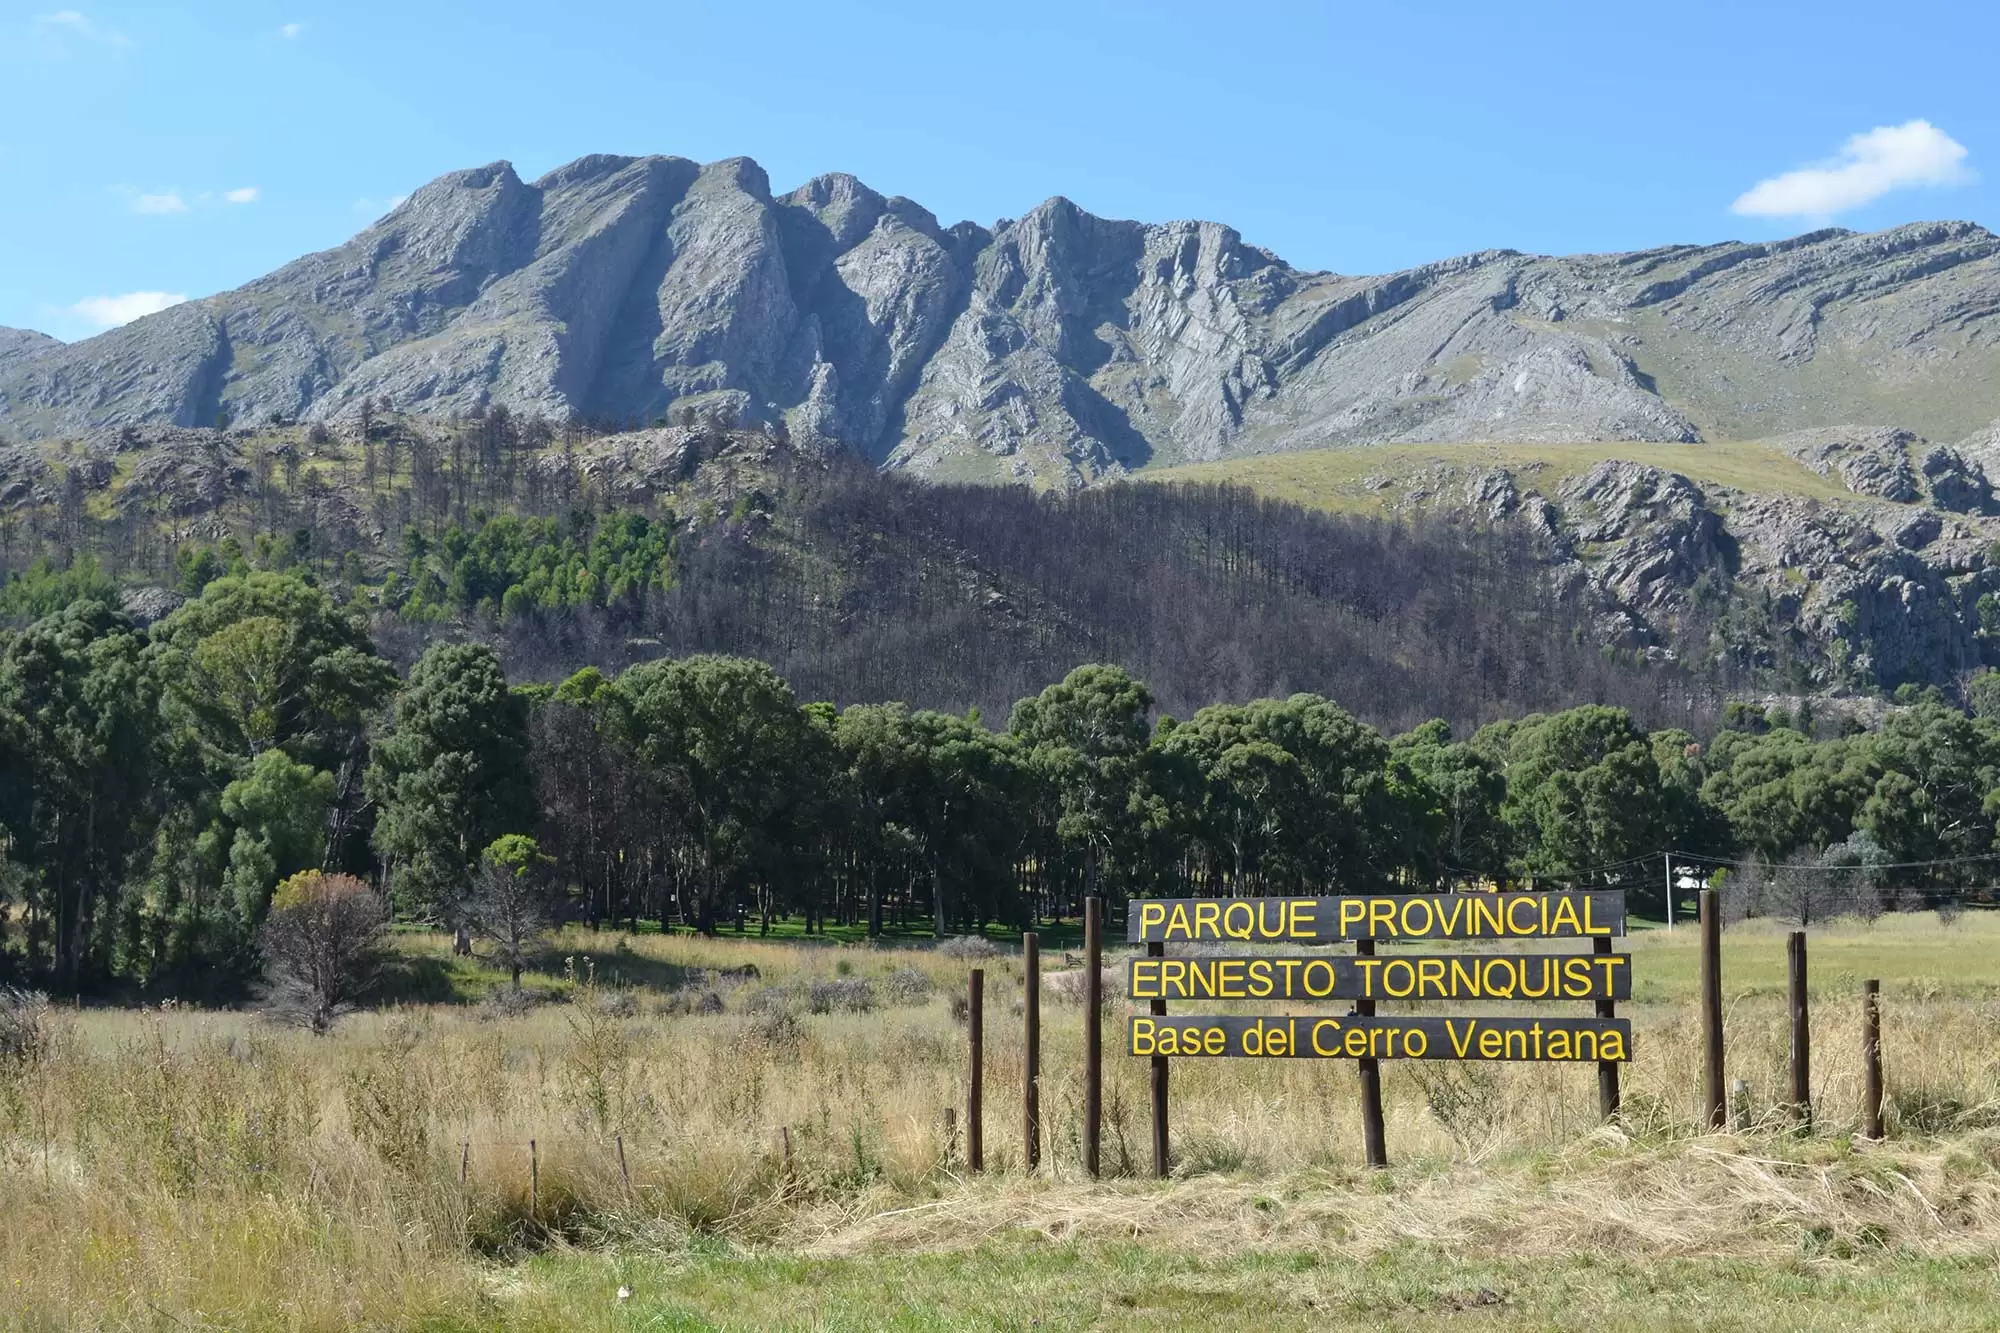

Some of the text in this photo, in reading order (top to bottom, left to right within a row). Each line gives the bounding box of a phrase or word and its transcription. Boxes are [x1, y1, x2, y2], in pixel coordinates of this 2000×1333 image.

[1139, 896, 1611, 939] PARQUE PROVINCIAL
[1132, 957, 1625, 1000] ERNESTO TORNQUIST
[1132, 1018, 1626, 1060] Base del Cerro Ventana
